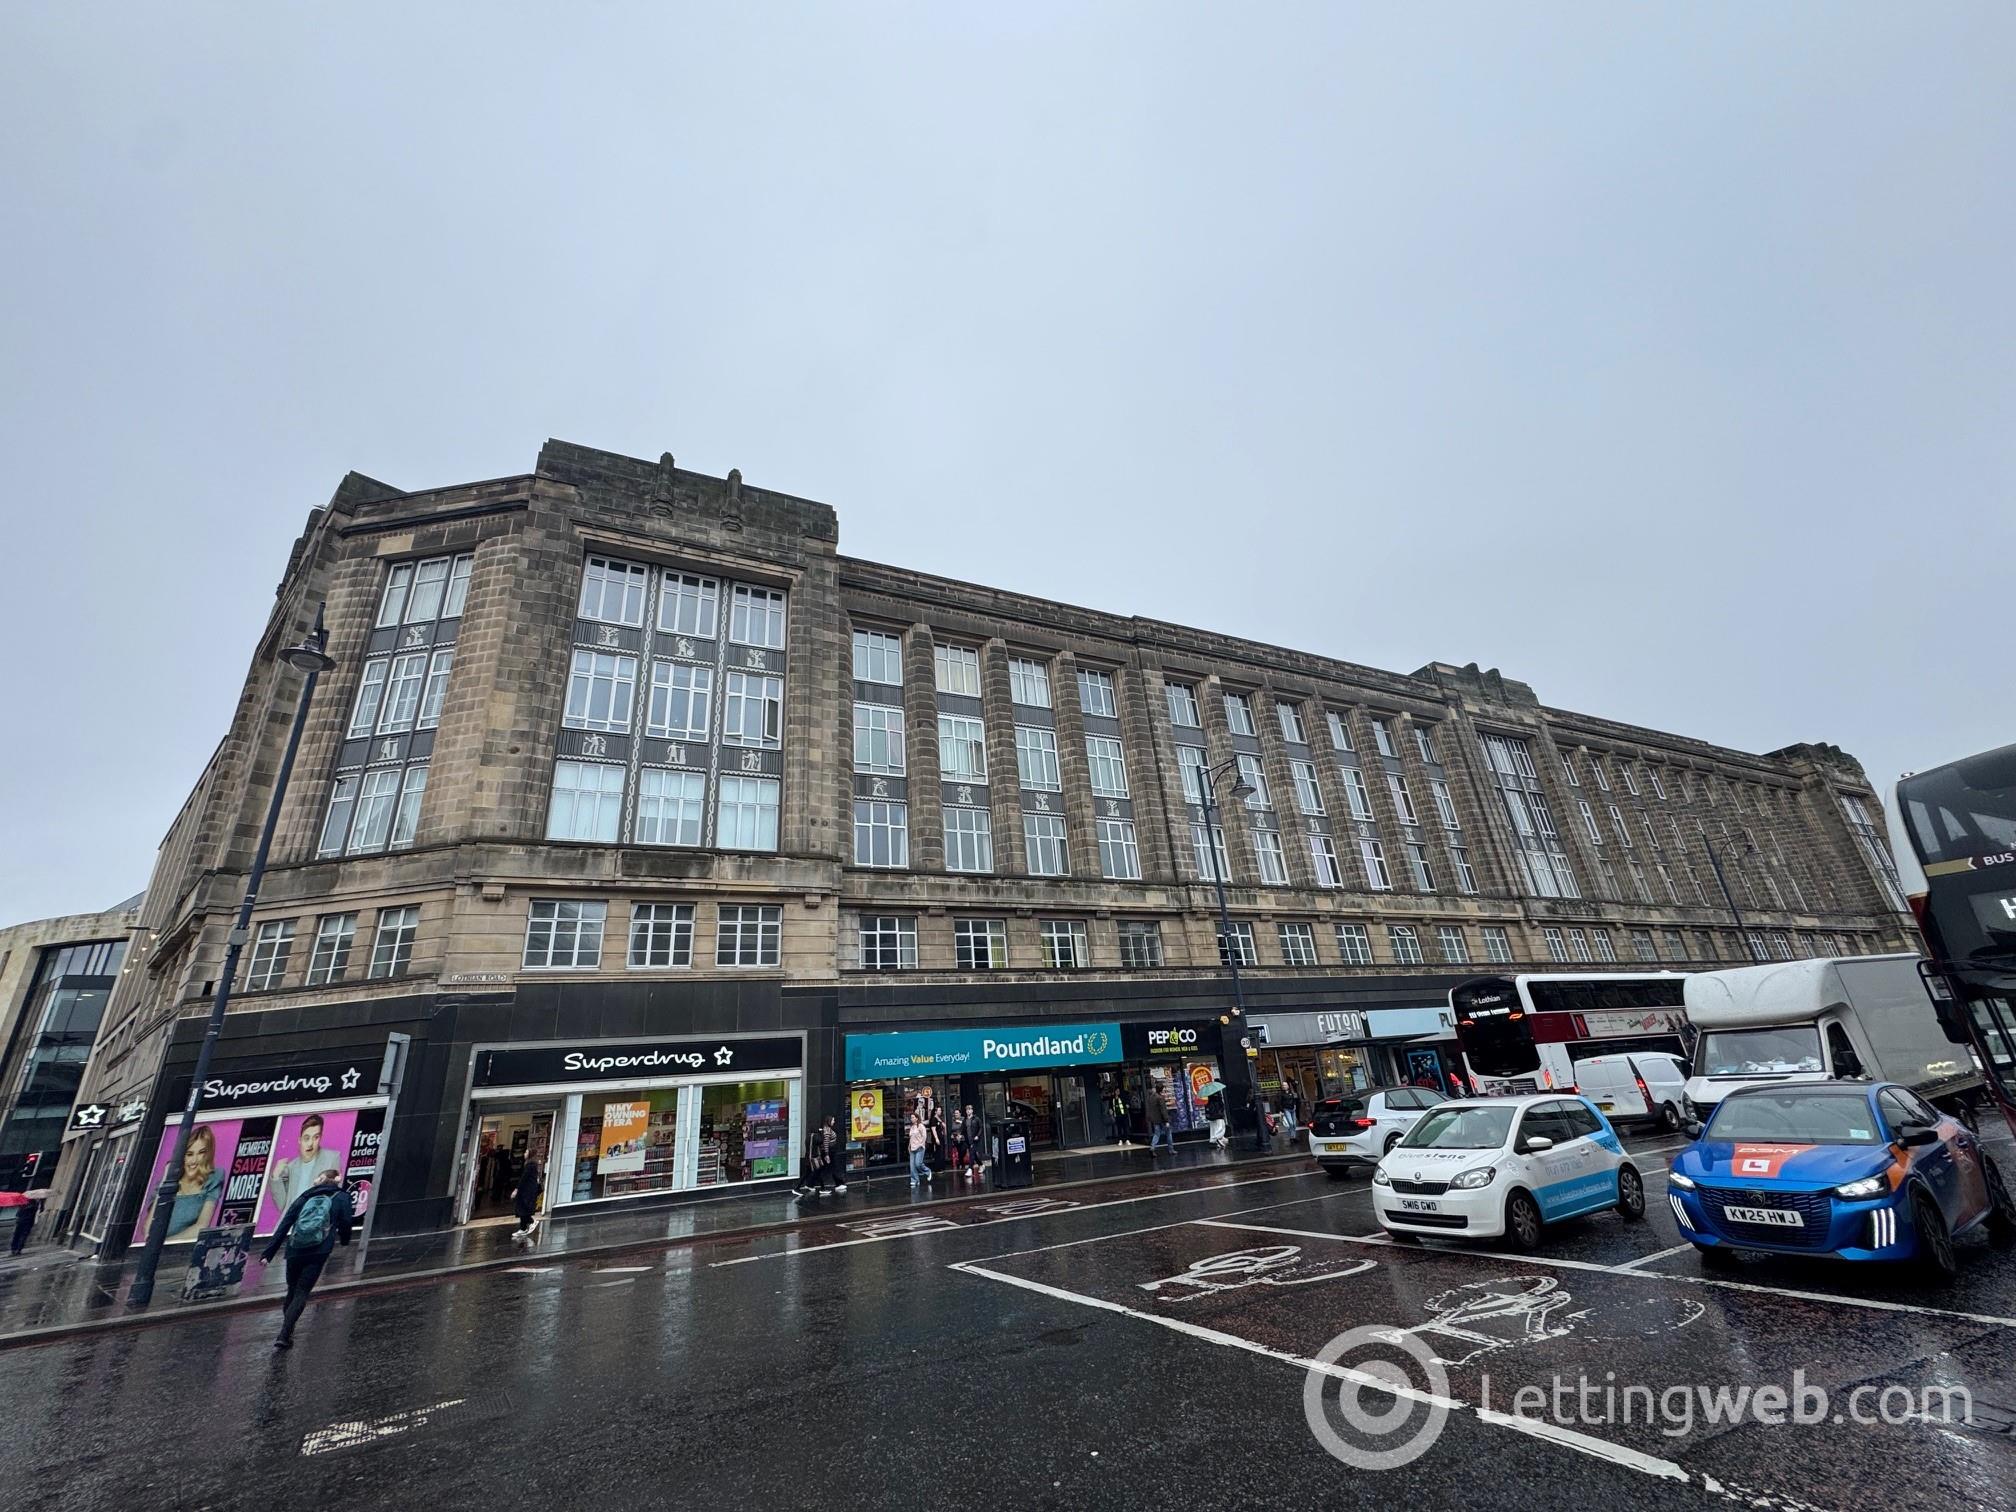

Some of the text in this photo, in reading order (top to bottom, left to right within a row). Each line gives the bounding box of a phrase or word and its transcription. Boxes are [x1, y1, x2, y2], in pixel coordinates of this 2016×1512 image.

[1983, 852, 2015, 866] BUS
[451, 974, 507, 982] LOTHIAN ROAD
[1478, 995, 1501, 1004] Lothian
[983, 1035, 1084, 1059] Poundland
[1241, 1039, 1250, 1047] 20
[564, 1051, 706, 1072] Superdrug
[874, 1052, 970, 1067] Amazing Value Everyday!
[203, 1075, 332, 1100] Superdrug
[616, 1103, 633, 1112] MY
[604, 1110, 646, 1120] OWNING
[613, 1118, 633, 1127] ERA
[236, 1140, 271, 1157] MEMBERS
[351, 1147, 377, 1157] order
[233, 1157, 267, 1174] SAVE
[226, 1173, 263, 1200] MORE
[1402, 1200, 1437, 1211] SM16 GWD
[1729, 1208, 1797, 1224] KW25 HWJ
